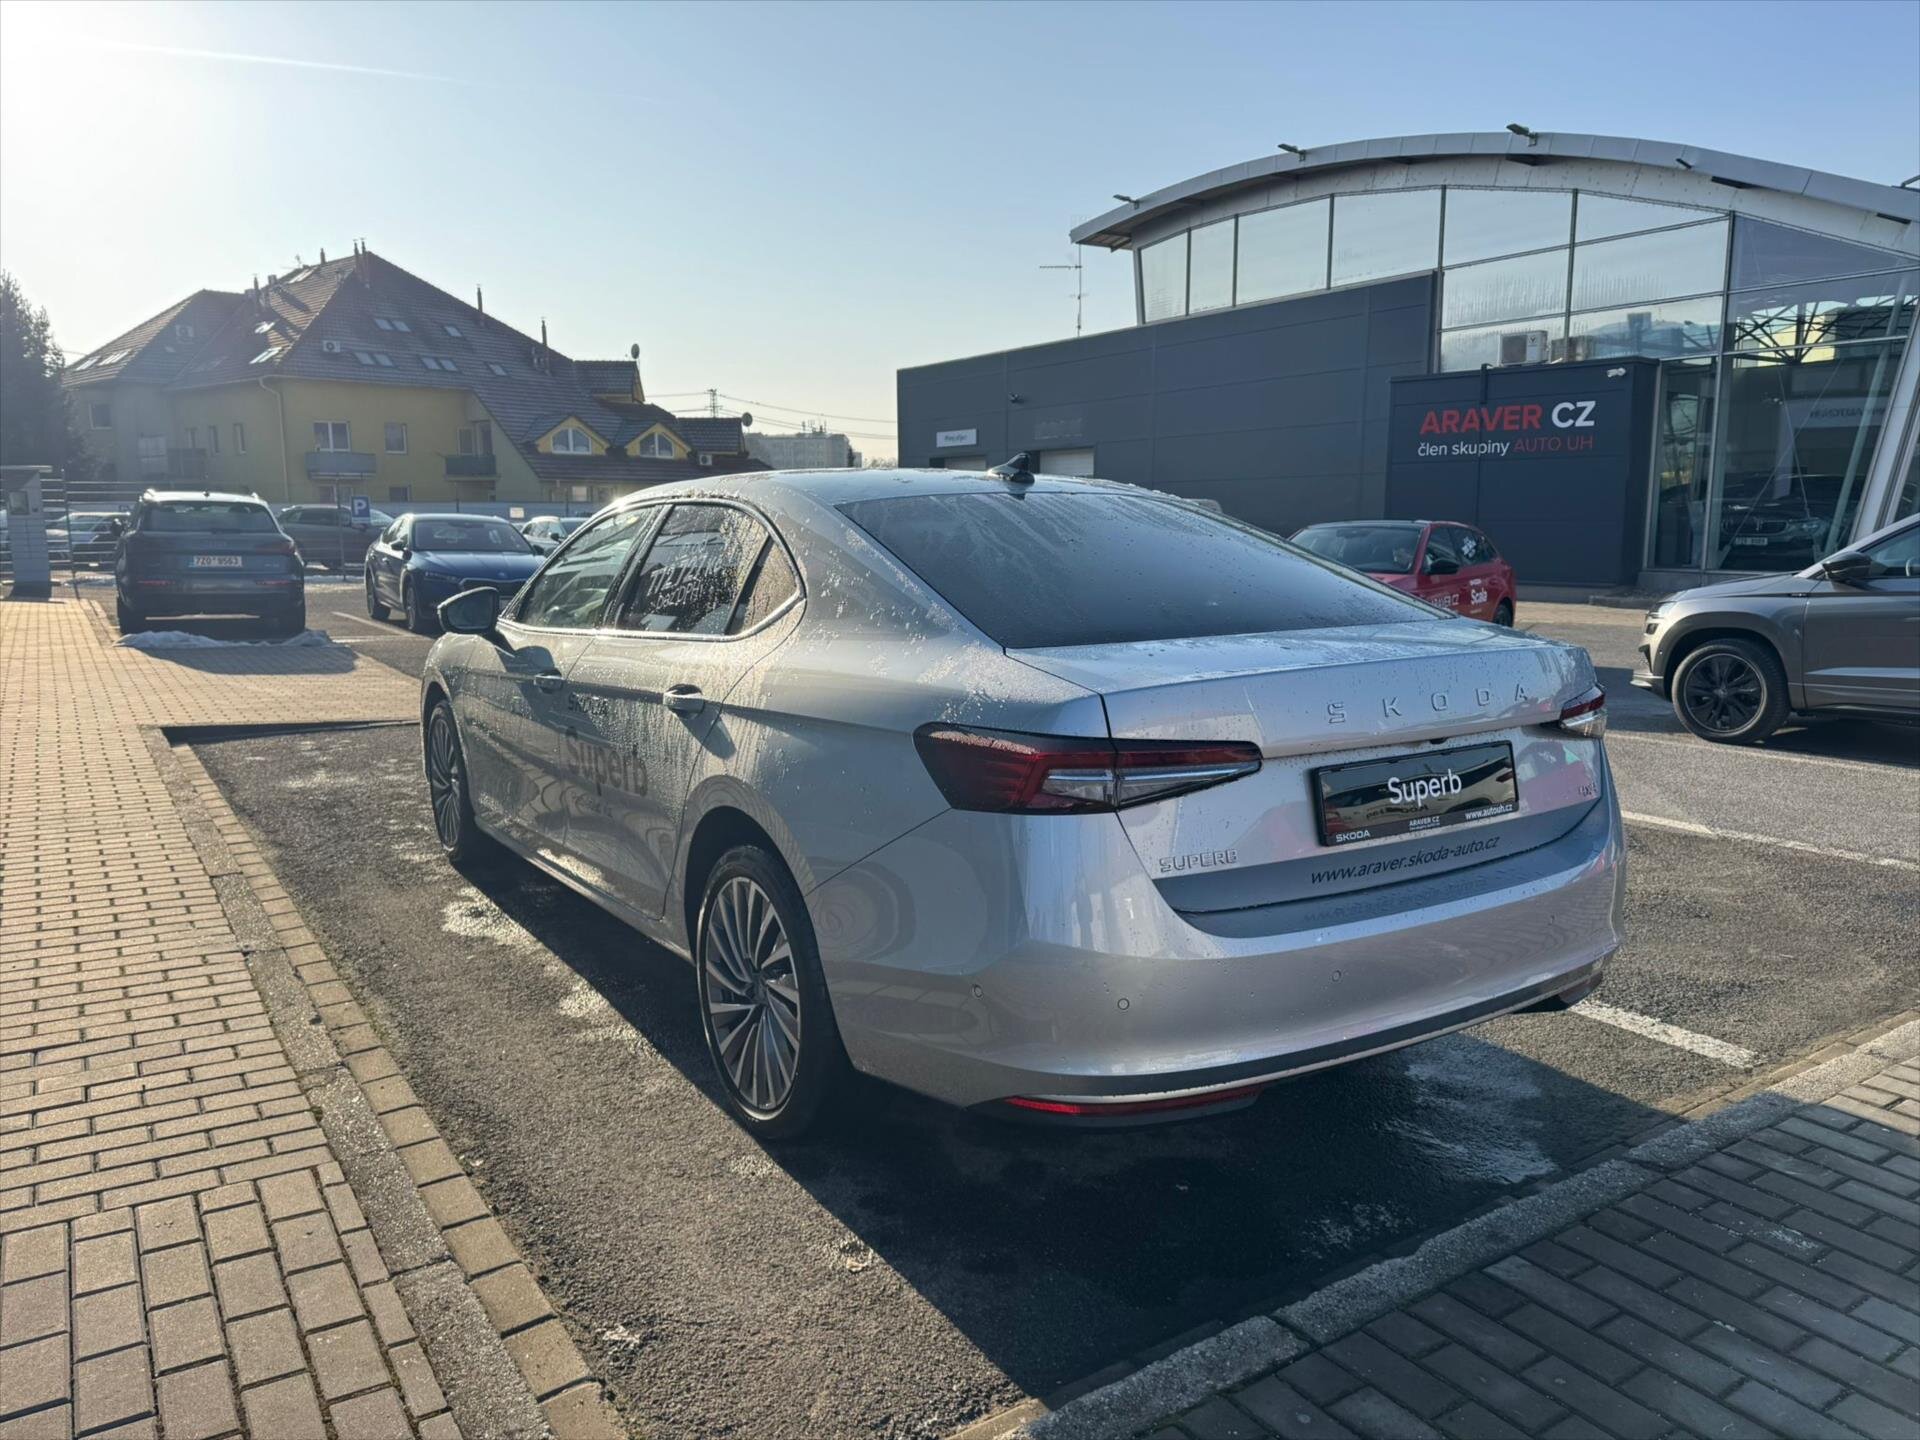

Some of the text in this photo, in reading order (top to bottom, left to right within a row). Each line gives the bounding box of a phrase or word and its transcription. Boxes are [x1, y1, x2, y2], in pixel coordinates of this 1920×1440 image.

[1420, 400, 1597, 435] ARAVER CZ
[1417, 435, 1594, 458] člen skupiny AUTO UH
[353, 499, 367, 515] P
[1387, 768, 1462, 807] Superb
[1464, 803, 1514, 820] www.autouh.cz
[1159, 849, 1237, 873] SUPERB
[1311, 835, 1500, 884] www.araver.skoda-auto.cz
